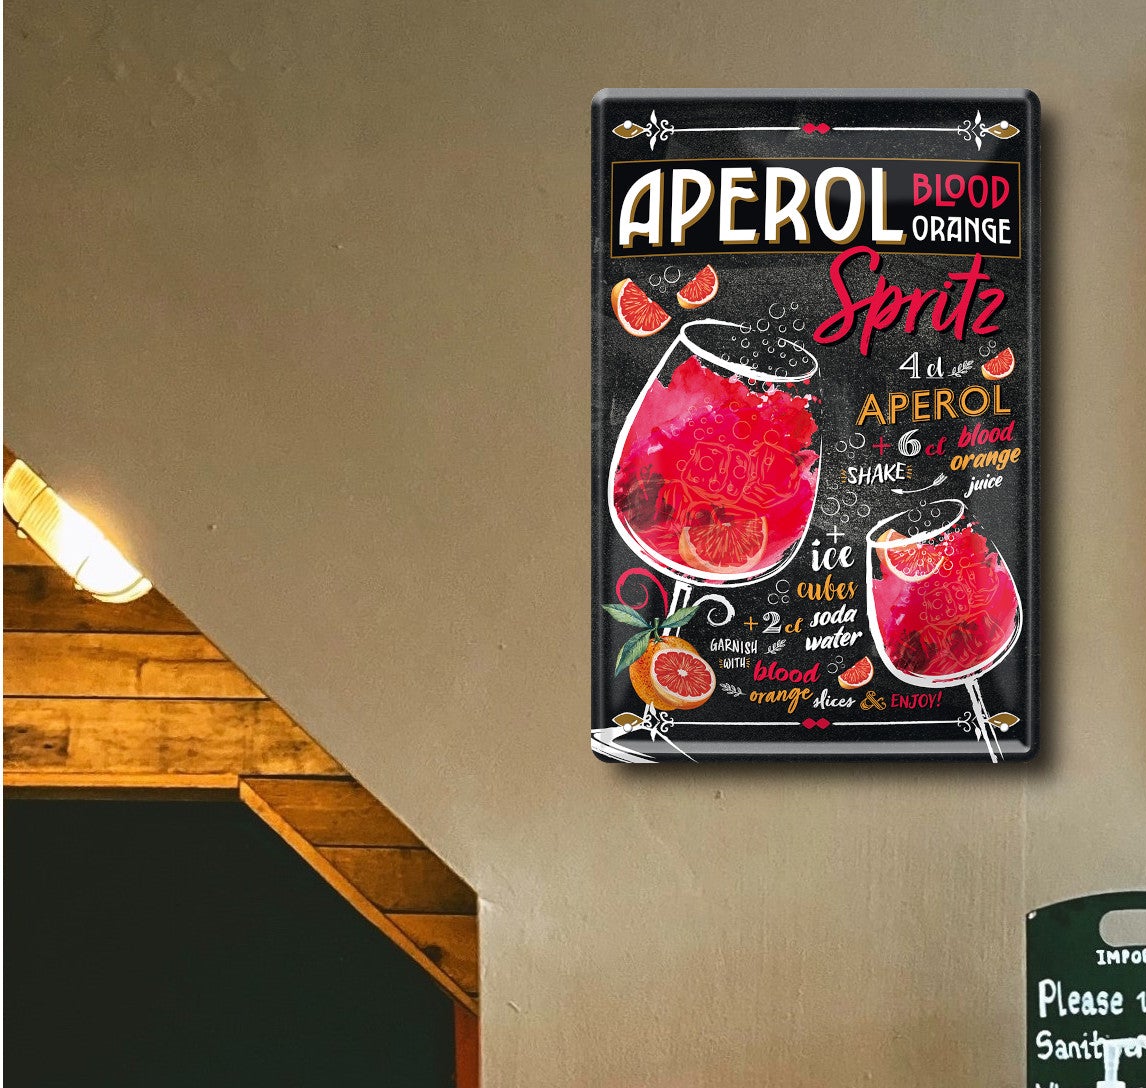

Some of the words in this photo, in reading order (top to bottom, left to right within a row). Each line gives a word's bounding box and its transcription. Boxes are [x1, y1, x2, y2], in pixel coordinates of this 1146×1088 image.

[912, 173, 1010, 209] BLOOD
[618, 166, 907, 247] APEROL
[912, 216, 1012, 245] ORANGE
[812, 246, 1006, 357] Spritz
[898, 351, 921, 379] 4
[855, 384, 1012, 426] APEROL
[898, 429, 921, 457] 6
[957, 420, 1016, 448] blood
[950, 447, 1021, 471] orange
[847, 461, 907, 486] SHAKE
[963, 474, 1004, 499] juice
[811, 538, 855, 572] ice
[796, 574, 858, 601] cubes
[761, 612, 783, 634] 2
[809, 603, 858, 629] soda
[710, 638, 759, 655] GARNISH
[805, 629, 864, 652] water
[723, 656, 746, 670] WITH
[753, 659, 822, 684] blood
[749, 685, 814, 714] orange
[812, 688, 857, 711] slices
[859, 690, 887, 711] &
[890, 690, 943, 710] ENJOY!
[1038, 978, 1124, 1018] Please
